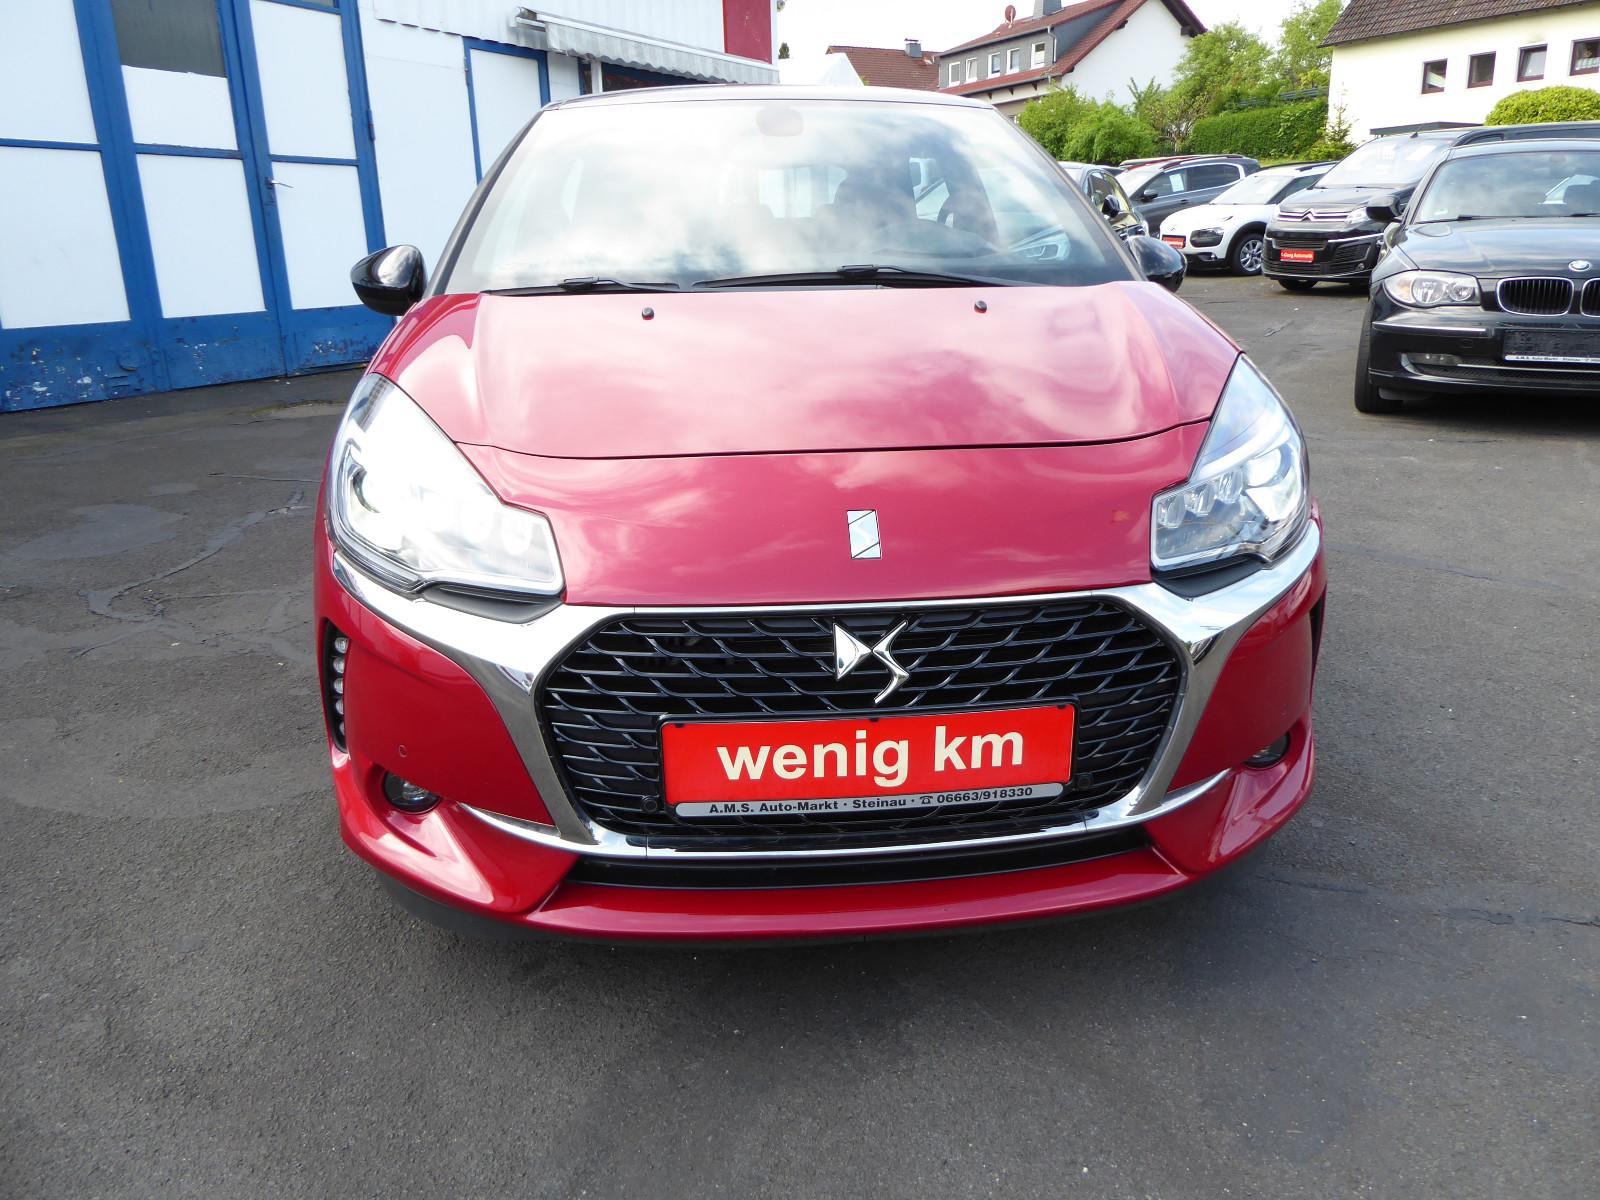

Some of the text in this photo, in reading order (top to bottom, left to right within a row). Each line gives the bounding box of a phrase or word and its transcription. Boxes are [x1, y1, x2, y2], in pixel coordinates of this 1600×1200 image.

[716, 725, 1024, 788] wenig km
[709, 787, 1034, 814] A.M.S. Auto-Markt Steinau 06663/918330
